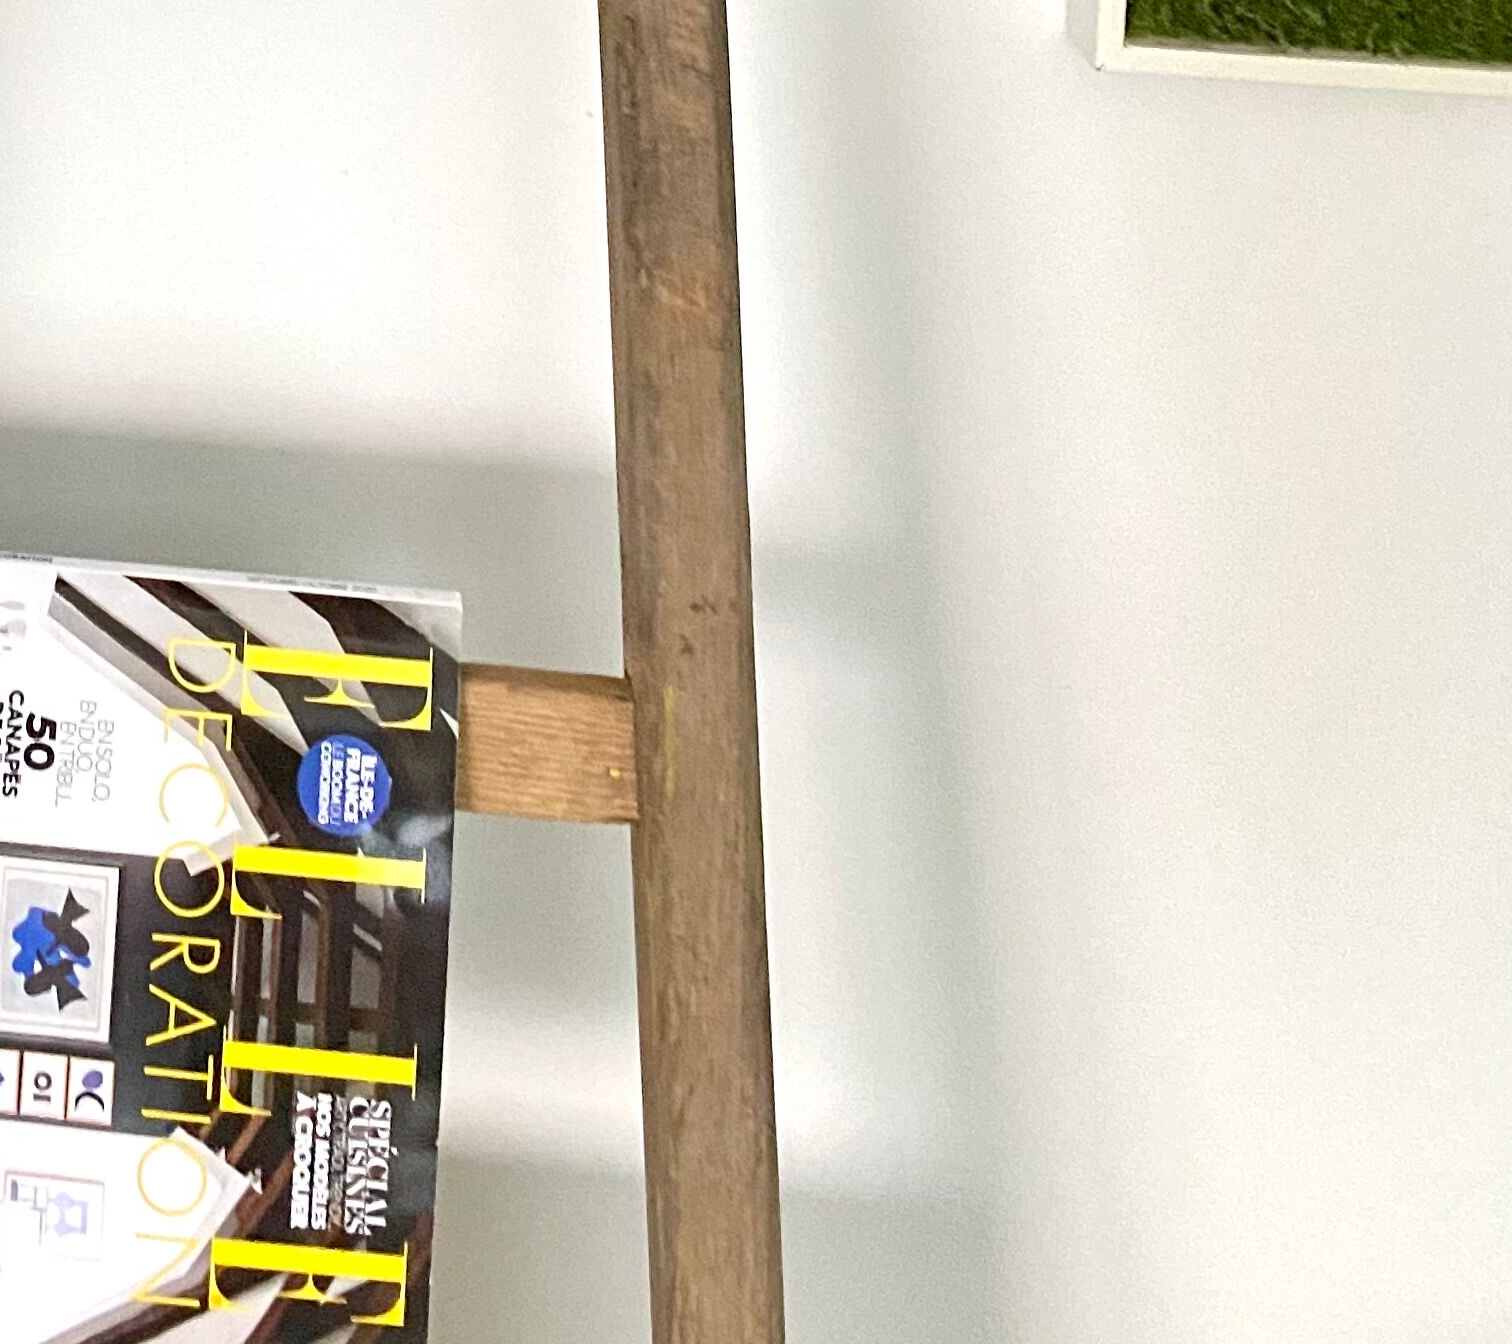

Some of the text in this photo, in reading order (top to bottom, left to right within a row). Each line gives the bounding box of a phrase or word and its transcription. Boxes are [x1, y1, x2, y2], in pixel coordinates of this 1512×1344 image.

[25, 712, 57, 771] 50
[208, 632, 434, 1326] ELLE
[291, 1116, 314, 1230] CROQUER
[316, 1092, 333, 1138] NOS
[344, 1096, 372, 1236] CUISINES
[364, 1098, 400, 1236] SPÉCIAL
